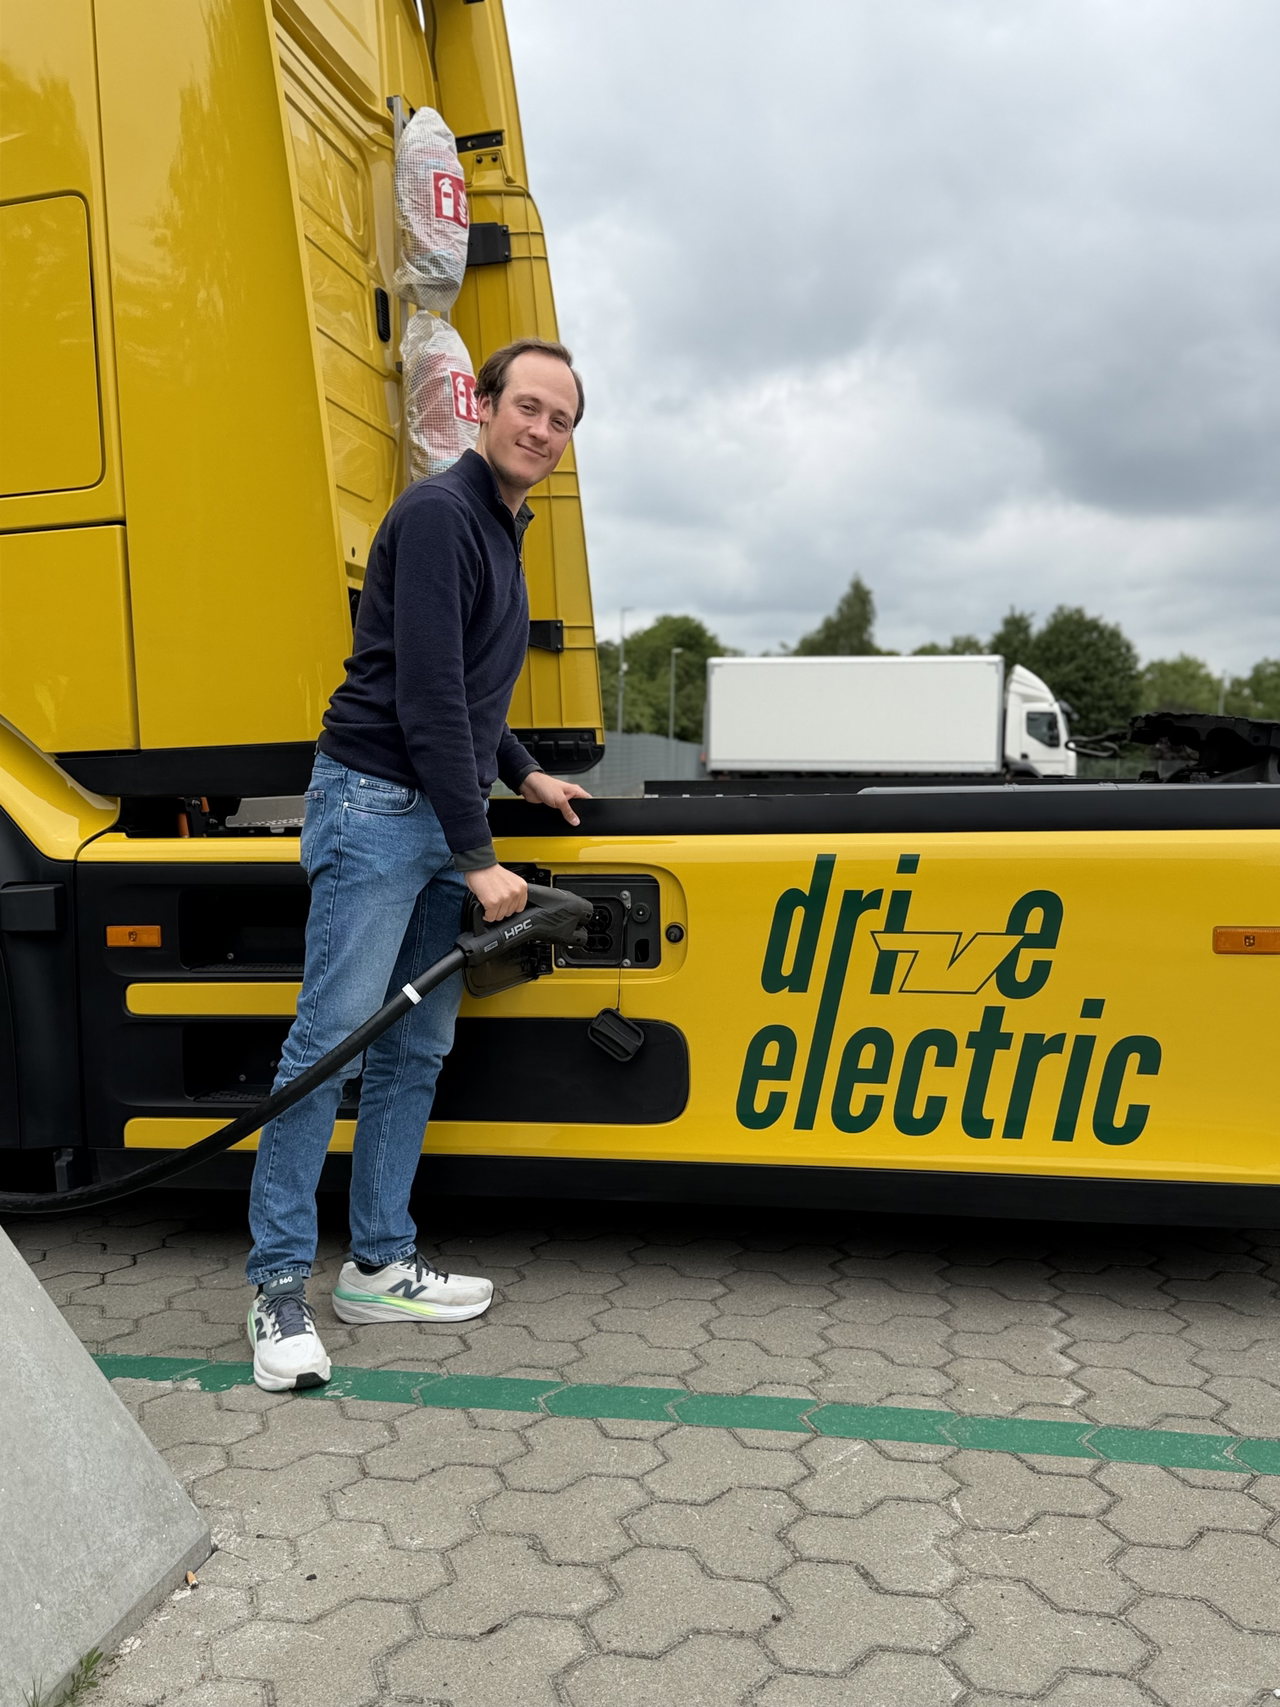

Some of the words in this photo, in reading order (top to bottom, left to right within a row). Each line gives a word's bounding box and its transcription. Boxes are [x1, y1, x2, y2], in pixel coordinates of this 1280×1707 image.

[504, 918, 533, 940] HPC
[760, 853, 1064, 1000] drive
[735, 998, 1162, 1146] electric
